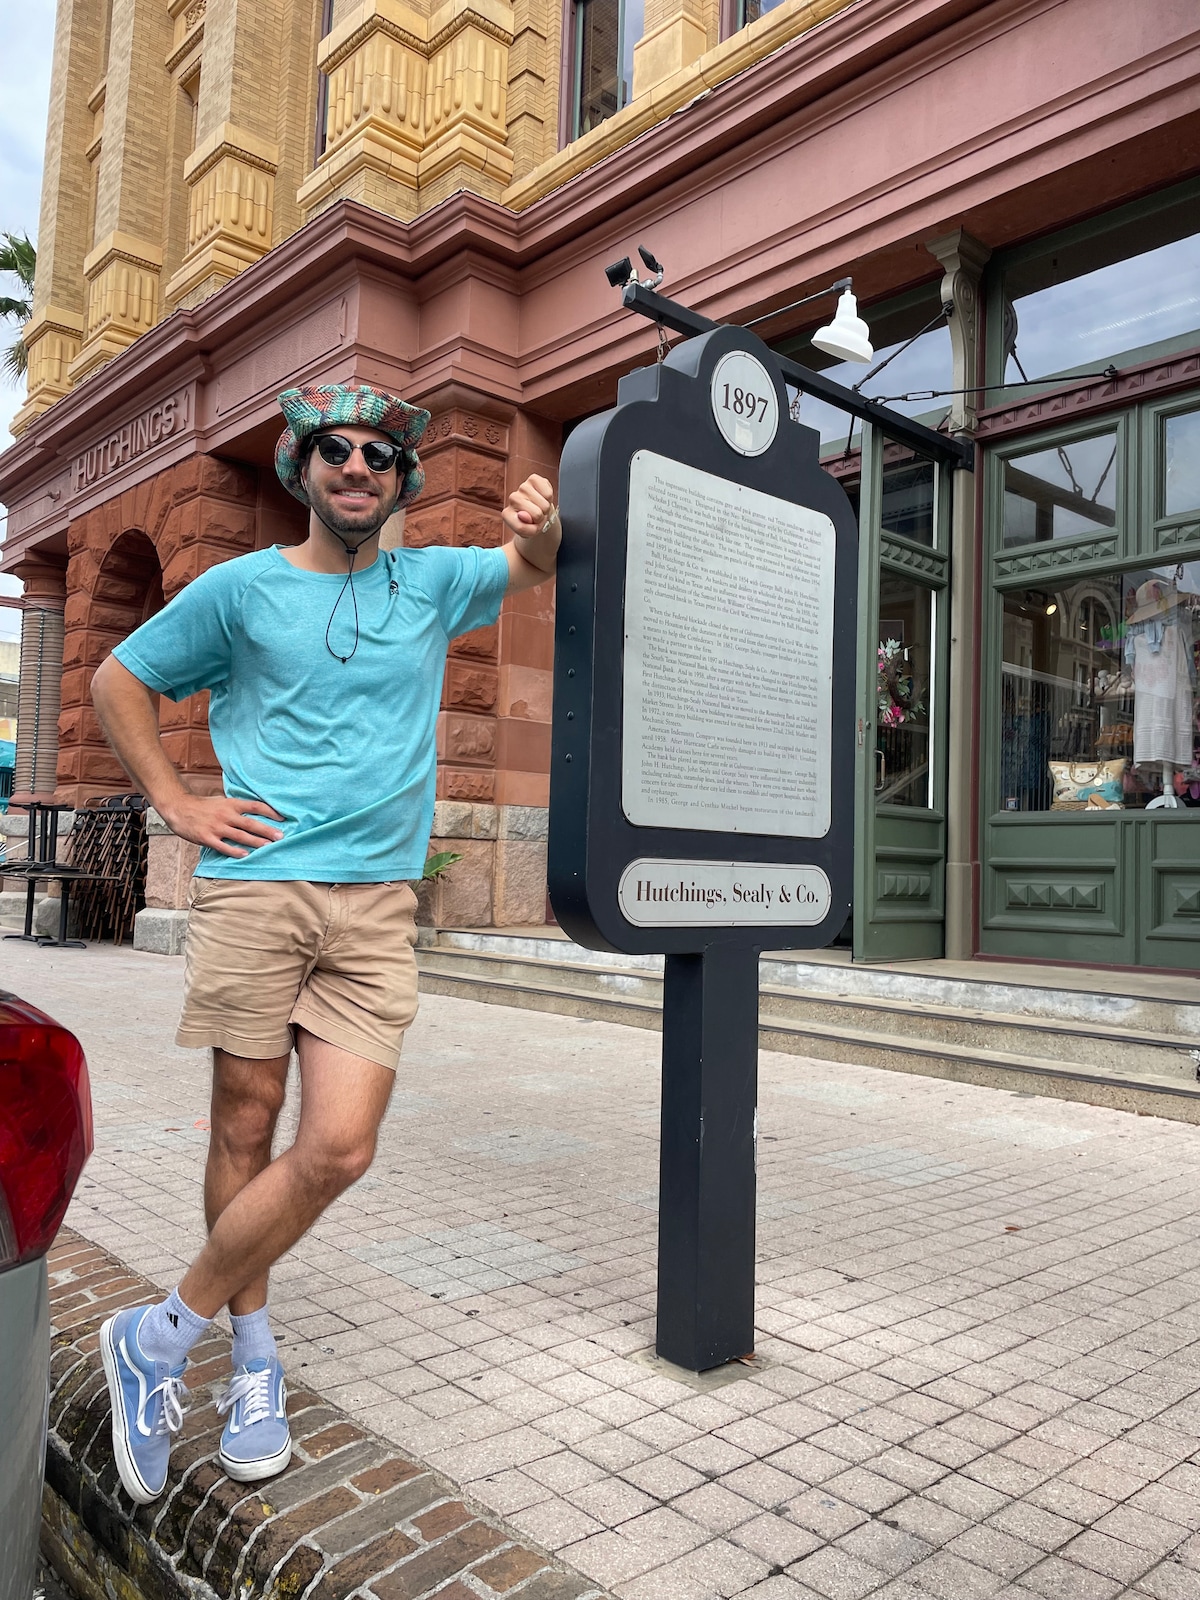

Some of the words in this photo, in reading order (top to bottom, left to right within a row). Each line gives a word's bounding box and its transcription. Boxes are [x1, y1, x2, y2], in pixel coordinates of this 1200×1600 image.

[722, 383, 768, 423] 1897
[76, 398, 178, 490] HUTCHINGS
[636, 880, 727, 908] Hutchings,
[732, 882, 774, 909] Sealy
[779, 885, 792, 904] &
[796, 884, 819, 904] Co.
